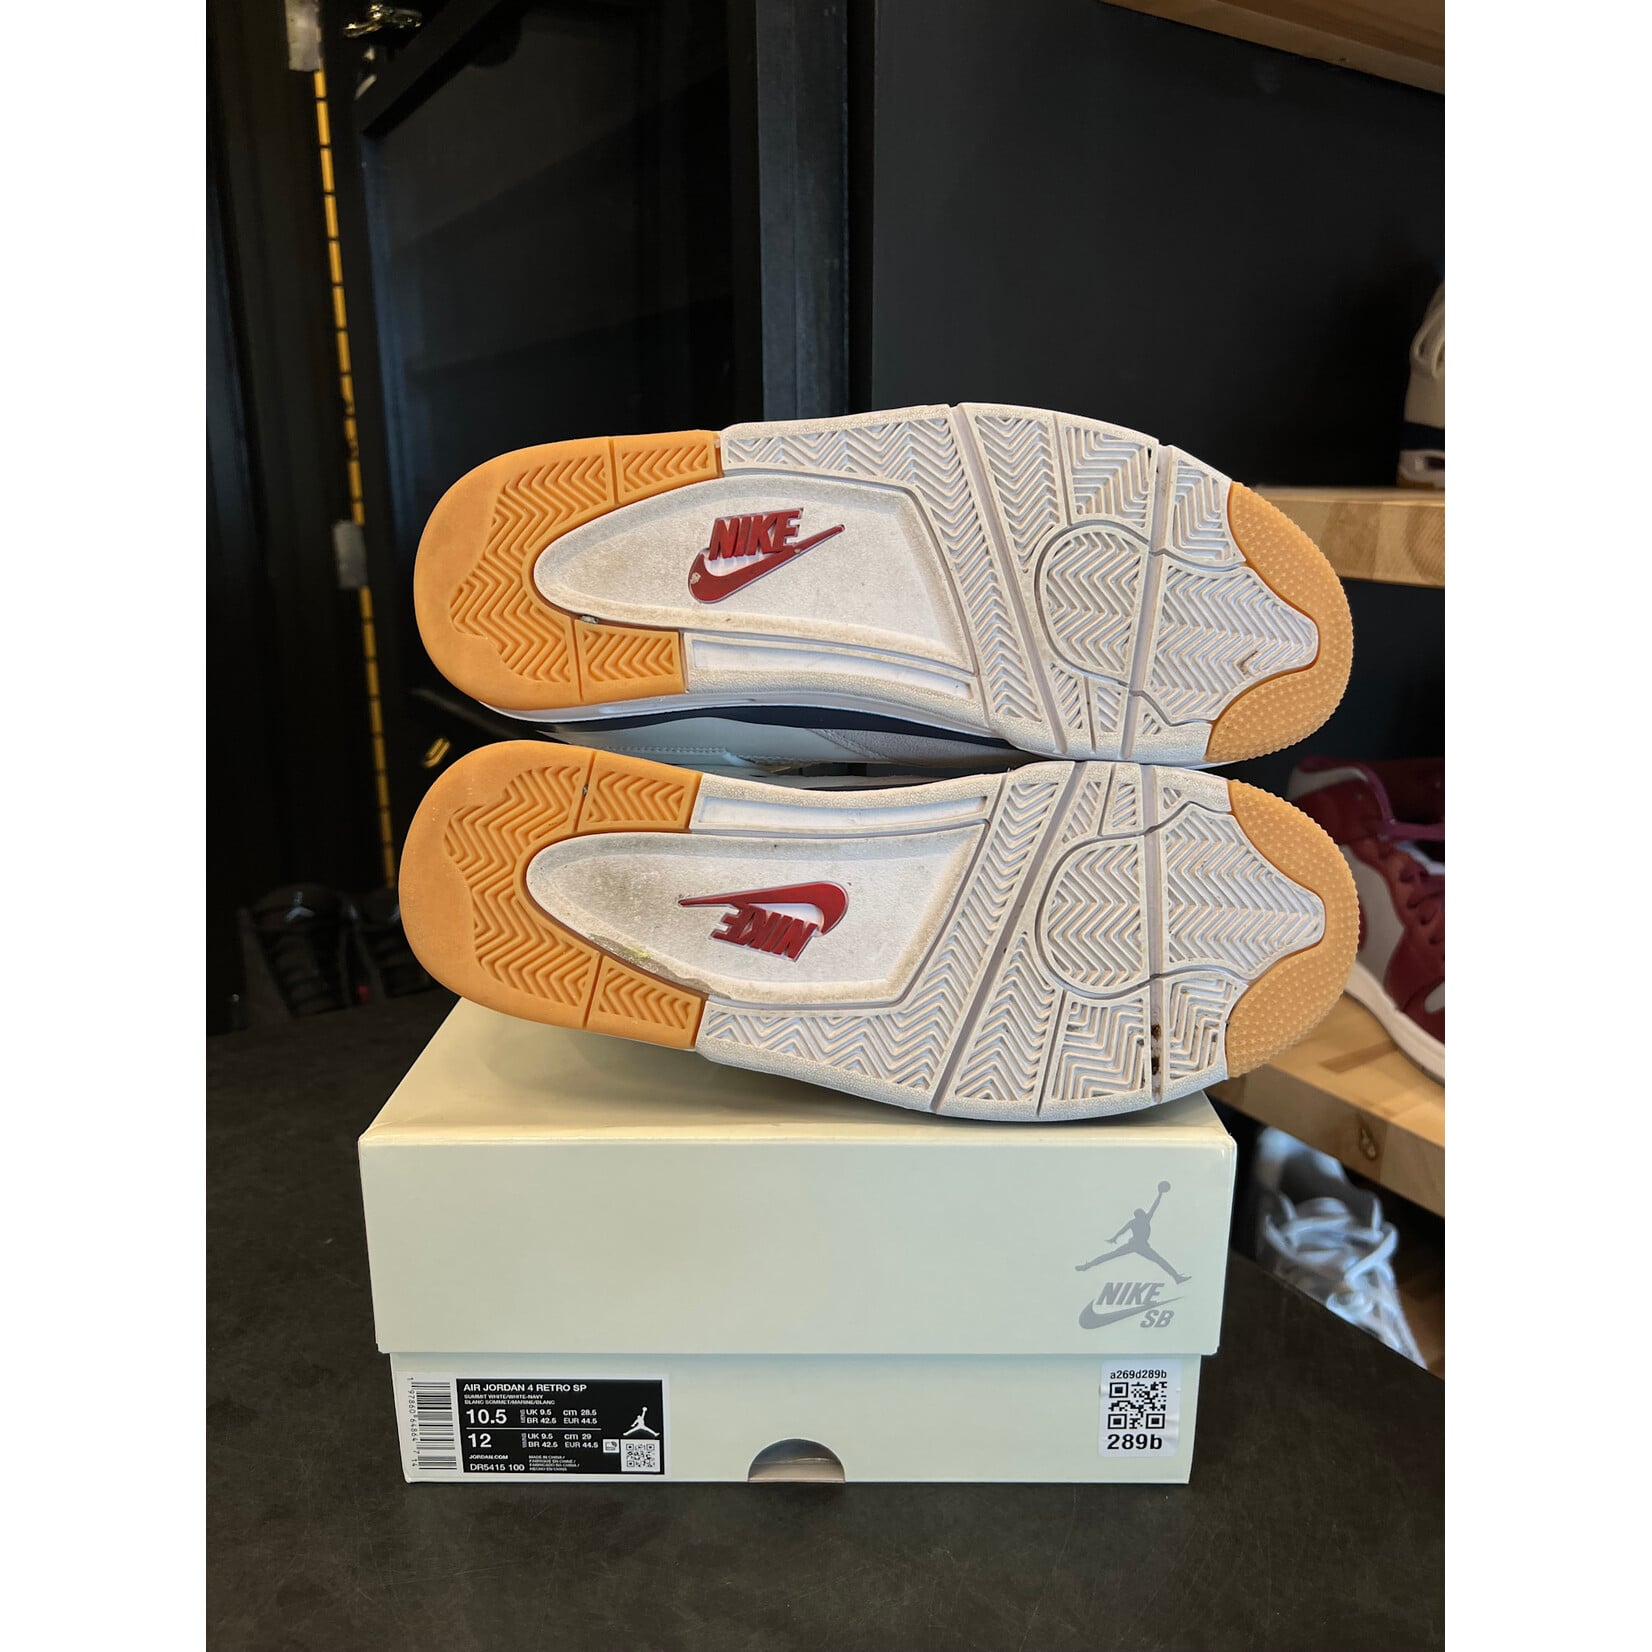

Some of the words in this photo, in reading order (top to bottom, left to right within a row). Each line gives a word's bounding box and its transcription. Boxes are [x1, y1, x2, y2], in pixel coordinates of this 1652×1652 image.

[708, 508, 803, 561] NIKE
[710, 904, 819, 961] NIKE
[1095, 1282, 1165, 1306] NIKE
[1140, 1309, 1175, 1328] SB
[1110, 1370, 1168, 1380] a269d289b
[463, 1383, 481, 1392] AIR
[482, 1383, 525, 1392] JORDAN
[527, 1383, 534, 1392] 4
[536, 1383, 572, 1392] RETRO
[573, 1384, 588, 1393] SP
[408, 1388, 417, 1414] 97860
[466, 1408, 508, 1425] 10.5
[526, 1408, 538, 1416] UK
[539, 1408, 552, 1416] 9.5
[540, 1417, 557, 1425] 42.5
[563, 1417, 580, 1425] EUR
[580, 1417, 598, 1425] 44.5
[467, 1432, 492, 1448] 12
[541, 1441, 559, 1449] 42.5
[564, 1441, 581, 1449] EUR
[582, 1441, 599, 1449] 44.5
[1107, 1433, 1163, 1450] 289b
[469, 1463, 506, 1471] DR5415
[508, 1464, 525, 1472] 100
